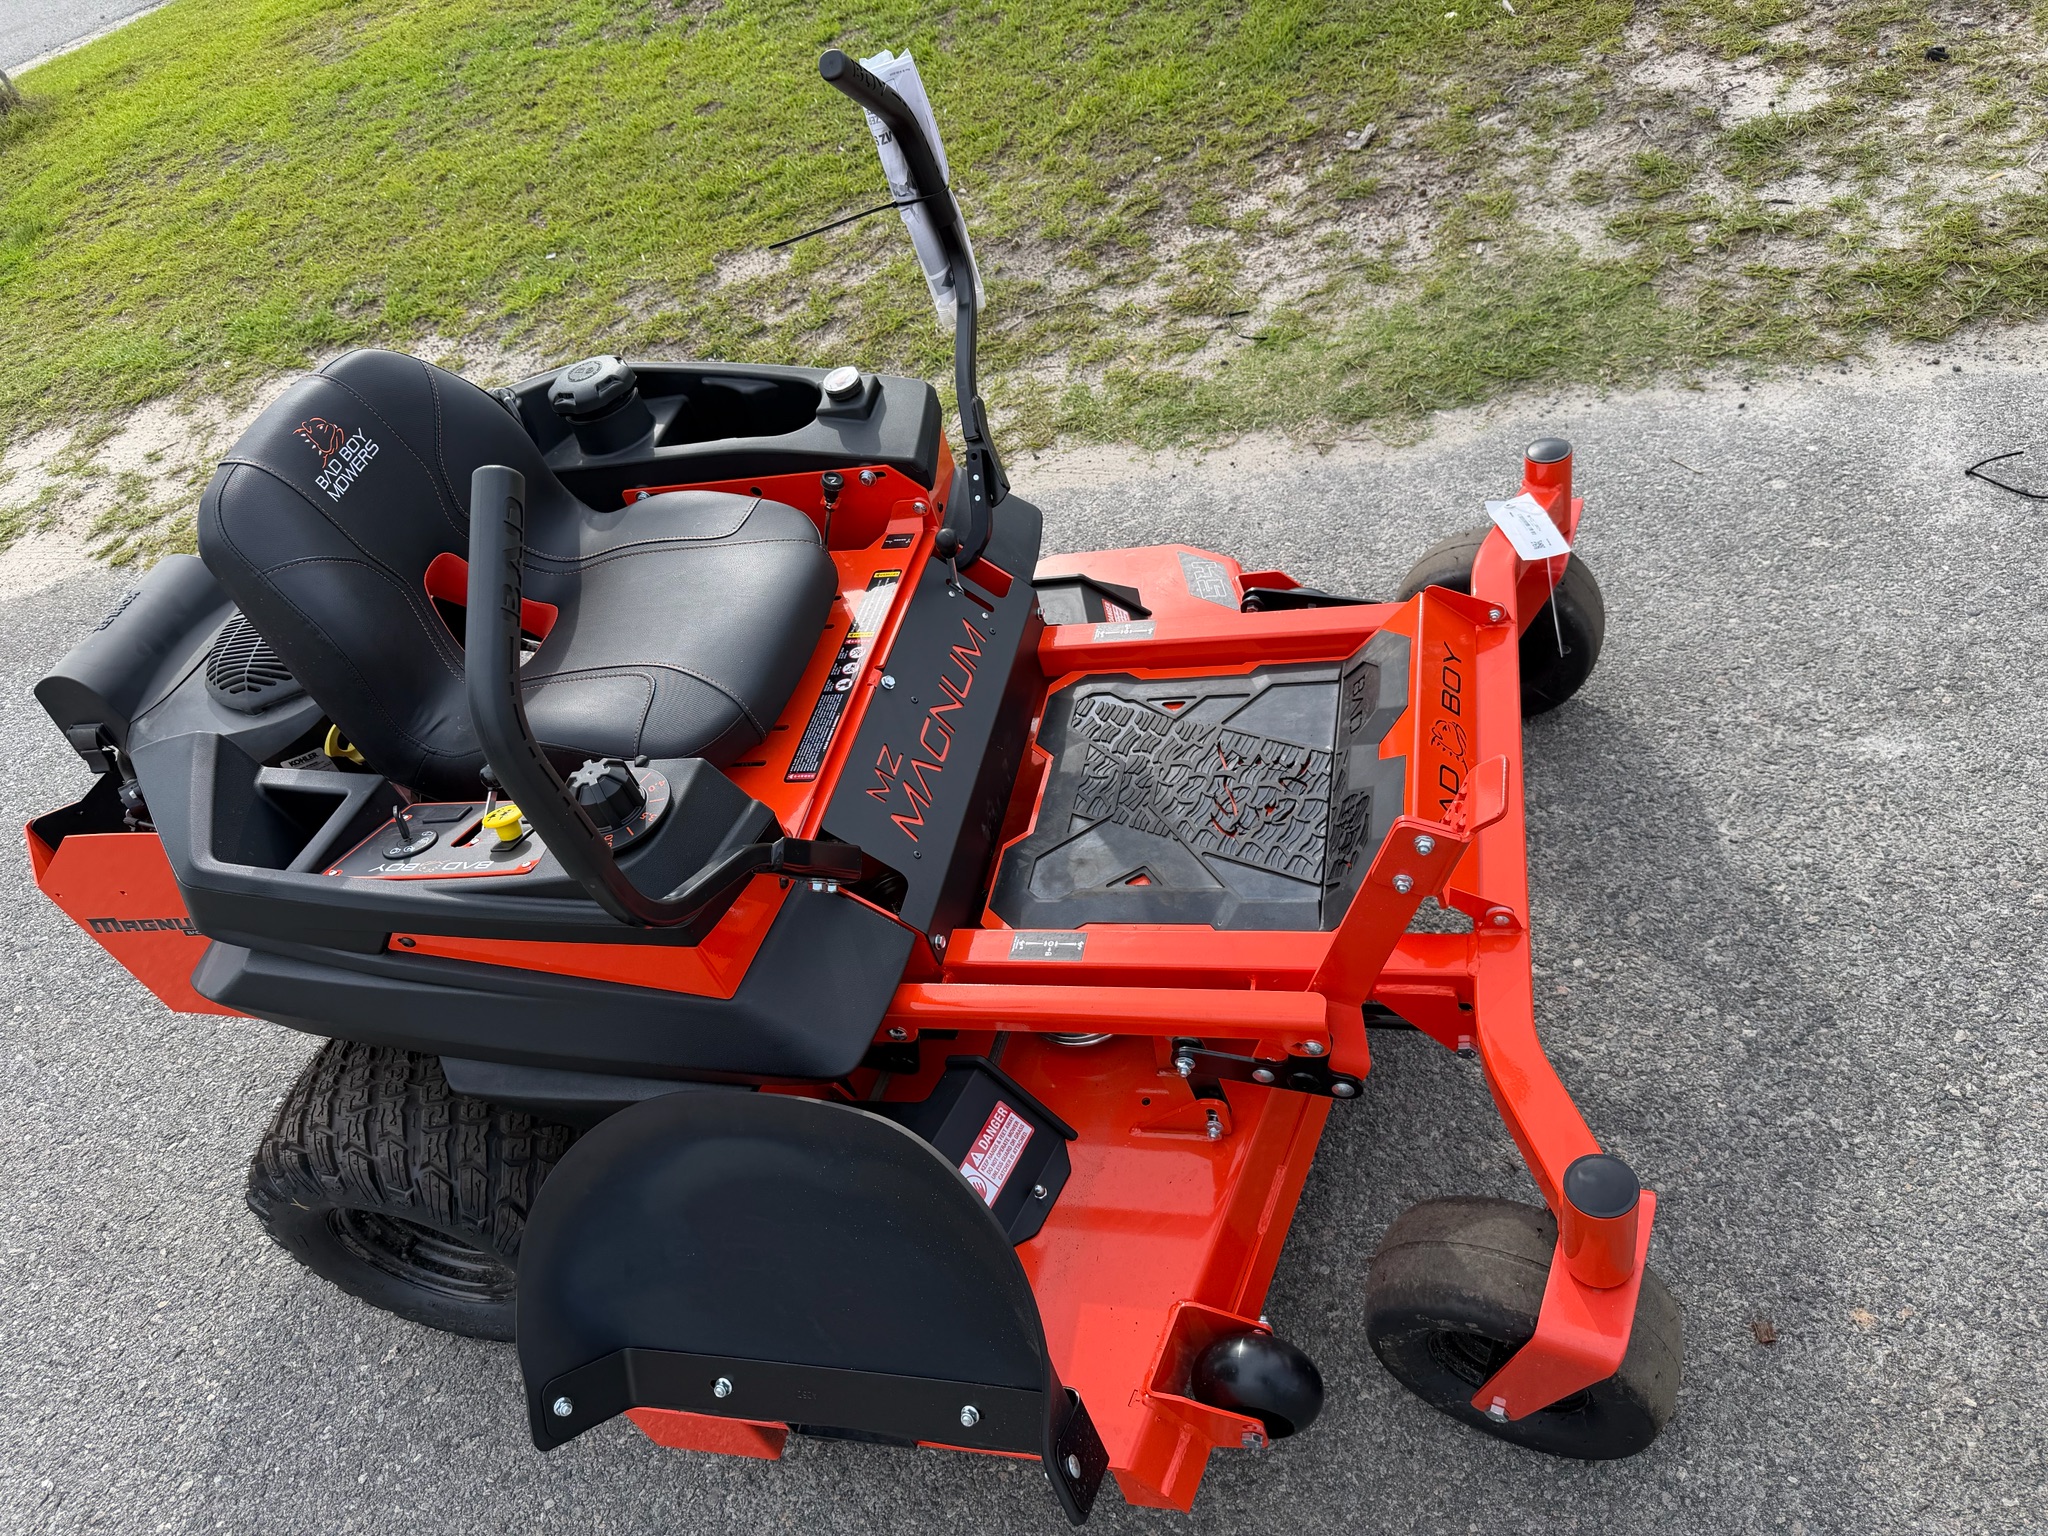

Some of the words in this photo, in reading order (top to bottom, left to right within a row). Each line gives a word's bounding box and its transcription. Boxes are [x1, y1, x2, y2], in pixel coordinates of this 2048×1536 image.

[314, 459, 343, 490] BAD
[339, 427, 367, 461] BOY
[327, 438, 379, 502] MOWERS
[1349, 674, 1366, 734] BAD
[1441, 641, 1462, 717] BOY
[890, 617, 986, 842] MAGNUM
[288, 751, 319, 767] KOHLER
[866, 743, 904, 803] MZ
[1439, 764, 1460, 824] AD
[368, 862, 420, 873] BOY
[442, 860, 495, 871] BAD
[85, 917, 197, 934] MAGNU
[977, 1106, 1009, 1151] DANGER
[980, 1159, 990, 1173] KEEP
[986, 1143, 999, 1161] HANDS
[998, 1127, 1008, 1140] FEET
[986, 1167, 993, 1175] DO
[990, 1156, 999, 1168] NOT
[996, 1138, 1010, 1158] OPERATE
[1007, 1120, 1020, 1138] MOWER
[991, 1161, 1003, 1180] UNLESS
[1001, 1145, 1013, 1162] GUARD
[1014, 1123, 1025, 1139] GRASS
[998, 1158, 1012, 1180] CATCHER
